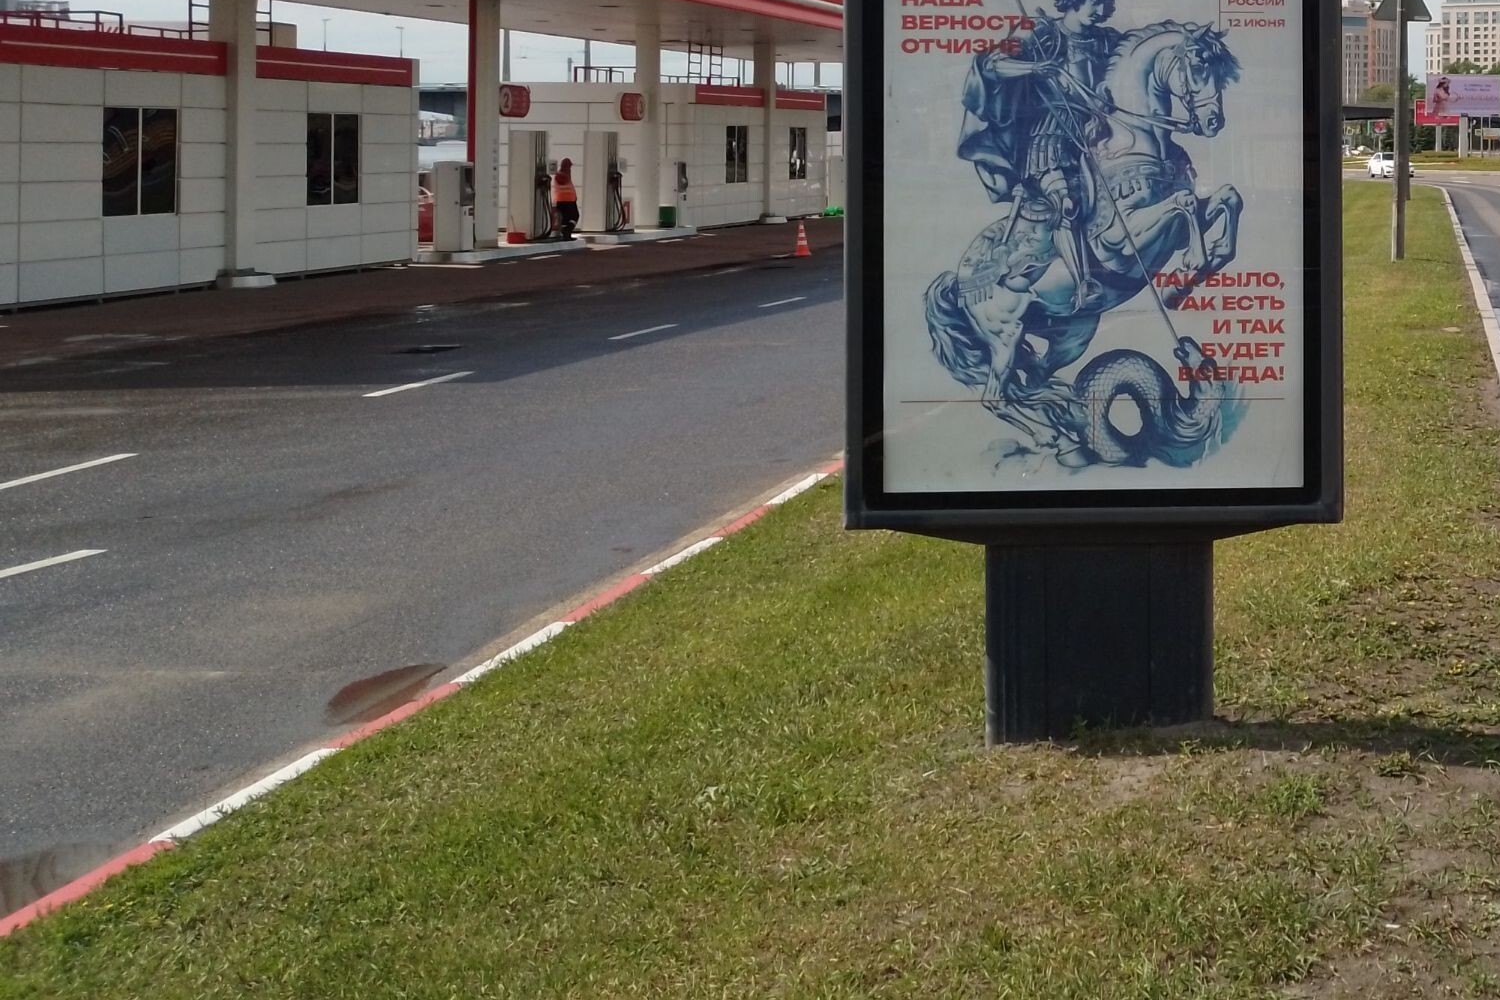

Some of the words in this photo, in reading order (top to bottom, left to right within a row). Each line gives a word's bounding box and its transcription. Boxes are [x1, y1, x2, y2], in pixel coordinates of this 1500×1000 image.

[901, 15, 1036, 31] ВЕРНОСТЬ
[1228, 19, 1241, 27] 12
[1244, 19, 1285, 28] ИЮНЯ
[901, 38, 1022, 54] ОТЧИЗНЕ
[1153, 272, 1200, 288] ТАК
[1205, 272, 1286, 289] БЫЛО,
[1221, 295, 1286, 311] ЕСТЬ
[1212, 319, 1231, 334] И
[1236, 319, 1286, 334] ТАК
[1201, 342, 1286, 361] БУДЕТ
[1178, 366, 1285, 384] ВСЕГДА!
